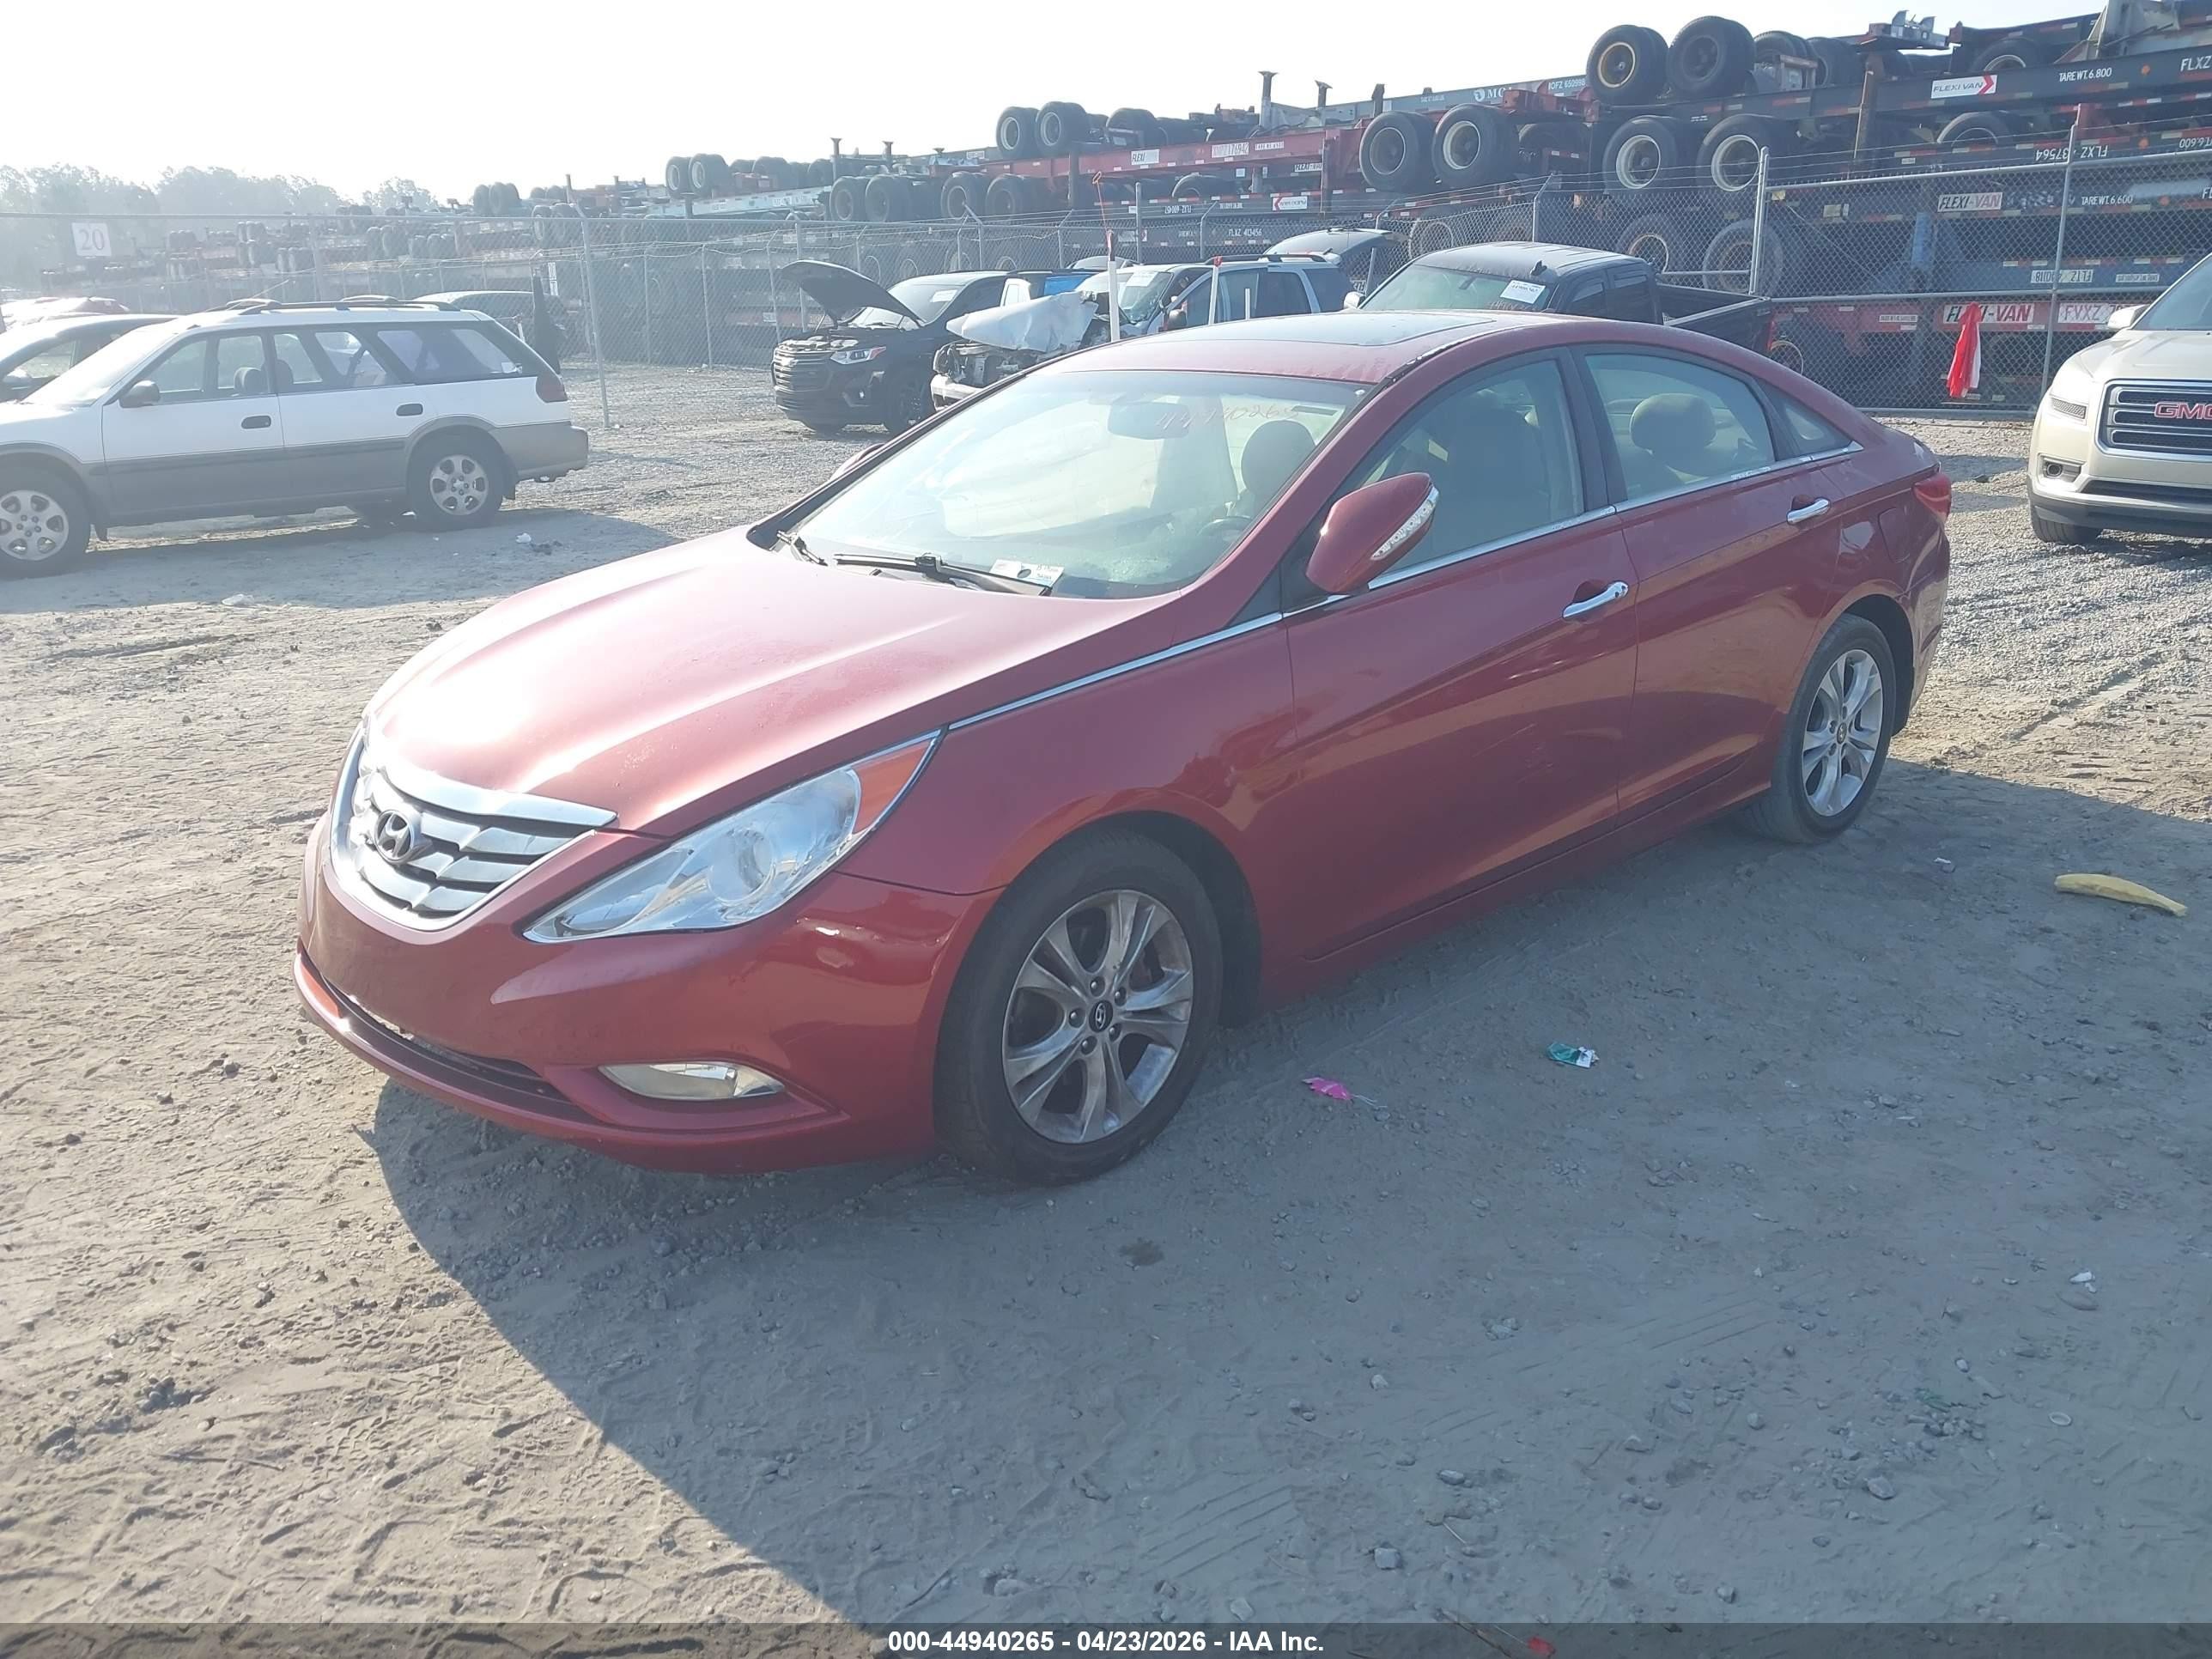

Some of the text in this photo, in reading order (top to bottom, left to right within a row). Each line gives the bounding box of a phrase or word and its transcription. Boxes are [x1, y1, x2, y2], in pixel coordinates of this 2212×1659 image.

[2035, 145, 2108, 161] FLXZ 37564
[1939, 195, 2001, 210] FLEXI-VAN
[78, 228, 104, 251] 20
[1947, 305, 2031, 322] FLI-VAN
